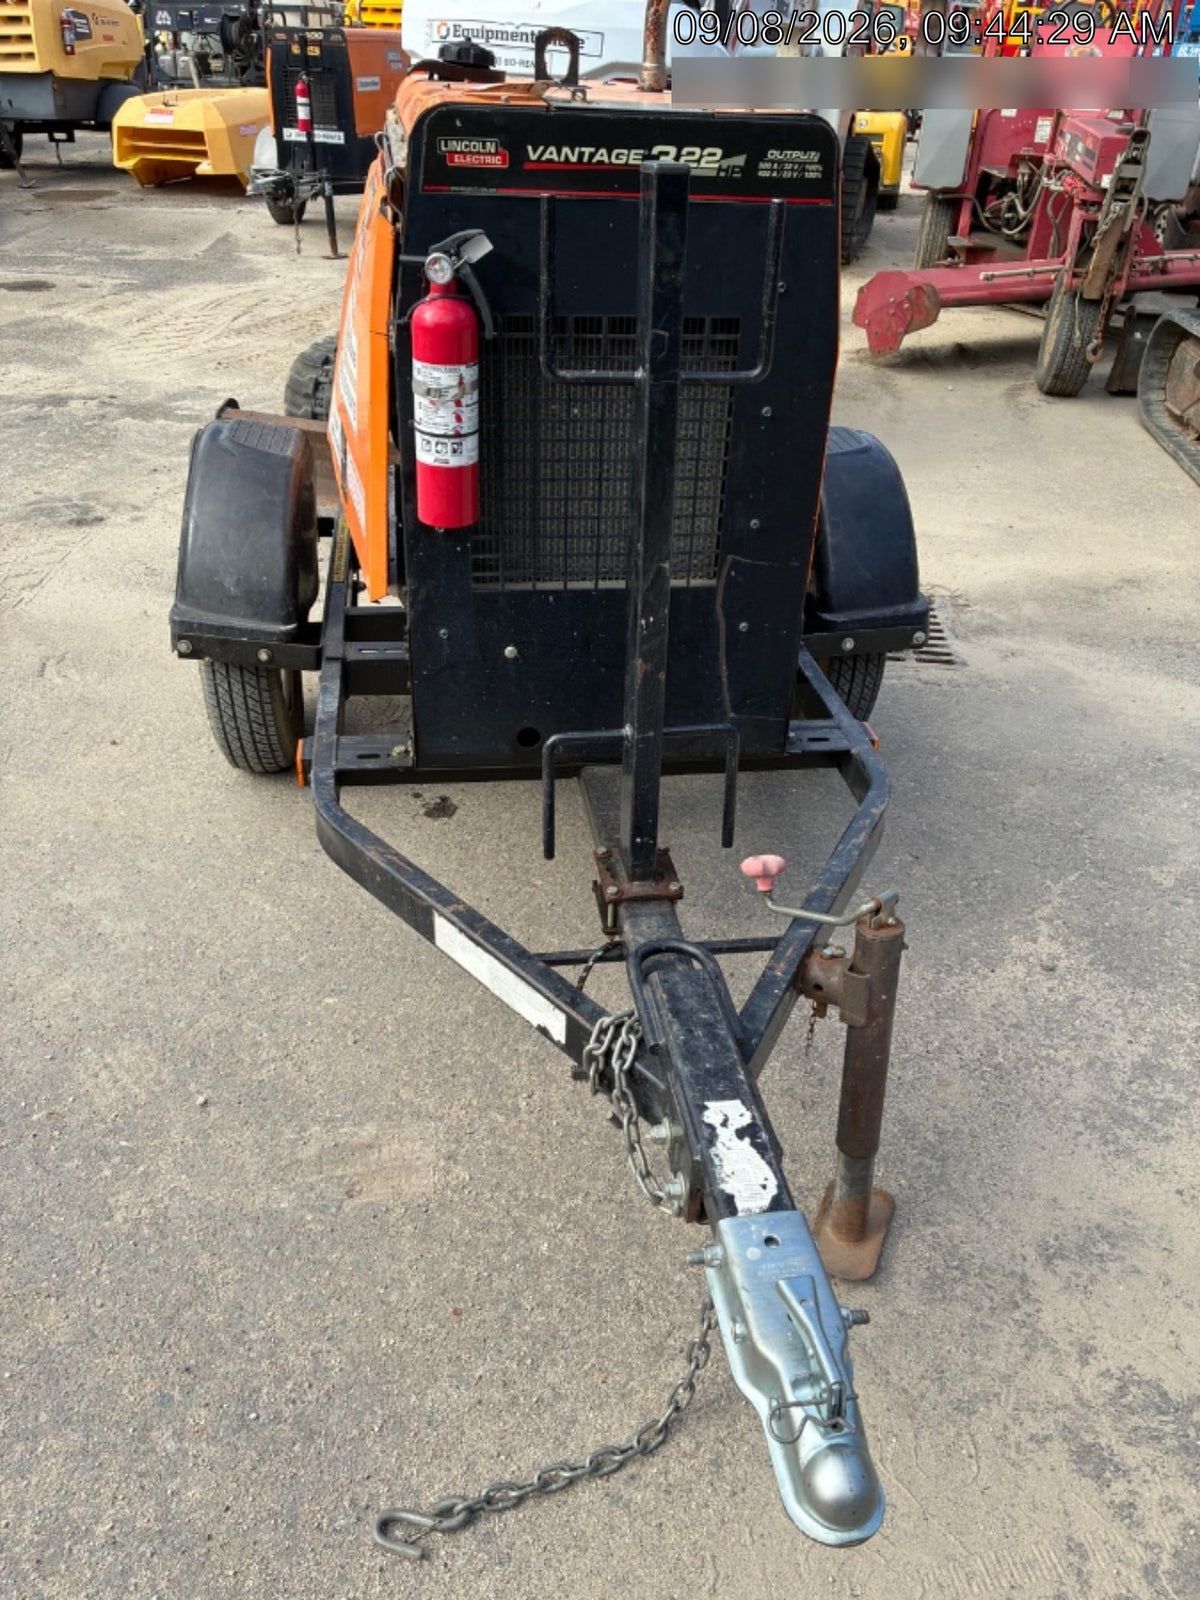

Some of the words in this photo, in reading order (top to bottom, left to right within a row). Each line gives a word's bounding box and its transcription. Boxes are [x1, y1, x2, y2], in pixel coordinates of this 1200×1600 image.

[440, 140, 496, 153] LINCOLN
[454, 153, 502, 164] ELECTRIC
[526, 144, 642, 164] VANTAGE
[651, 144, 724, 168] 322
[767, 150, 818, 160] OUTPUT
